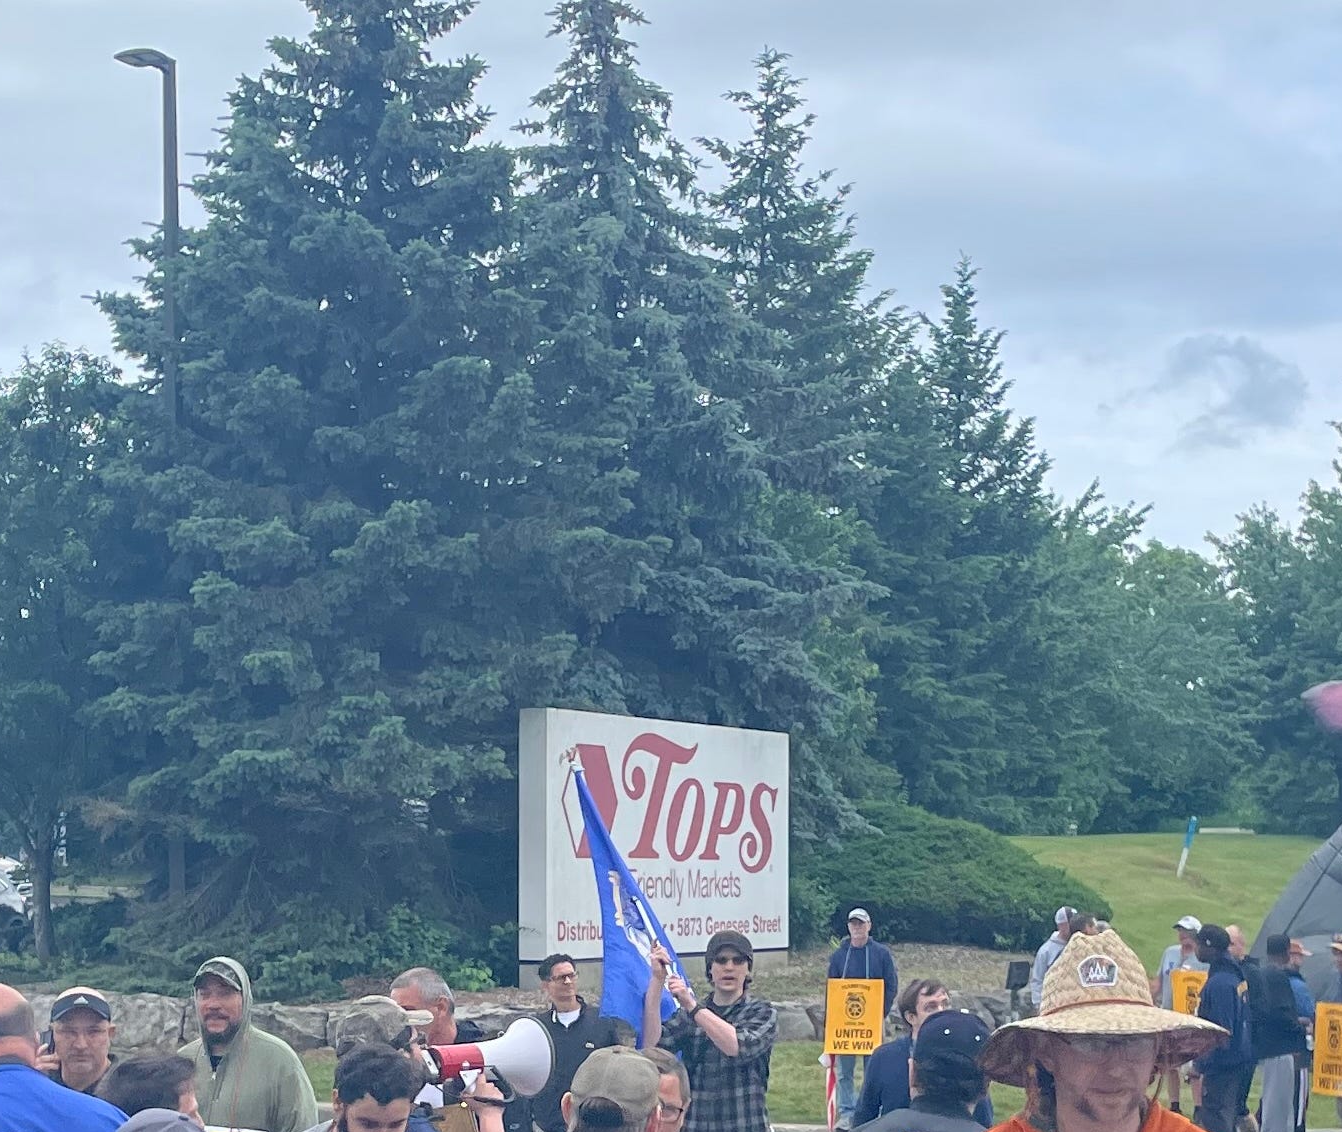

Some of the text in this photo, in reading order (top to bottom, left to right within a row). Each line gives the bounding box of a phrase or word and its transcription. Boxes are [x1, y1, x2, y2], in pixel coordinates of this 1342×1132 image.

[622, 732, 778, 874] TOPS
[629, 868, 741, 906] riendly Markets
[677, 917, 703, 937] 5873
[752, 914, 781, 934] Street
[835, 1028, 873, 1039] UNITED
[833, 1040, 874, 1051] WE WIN
[1318, 1077, 1331, 1090] WE
